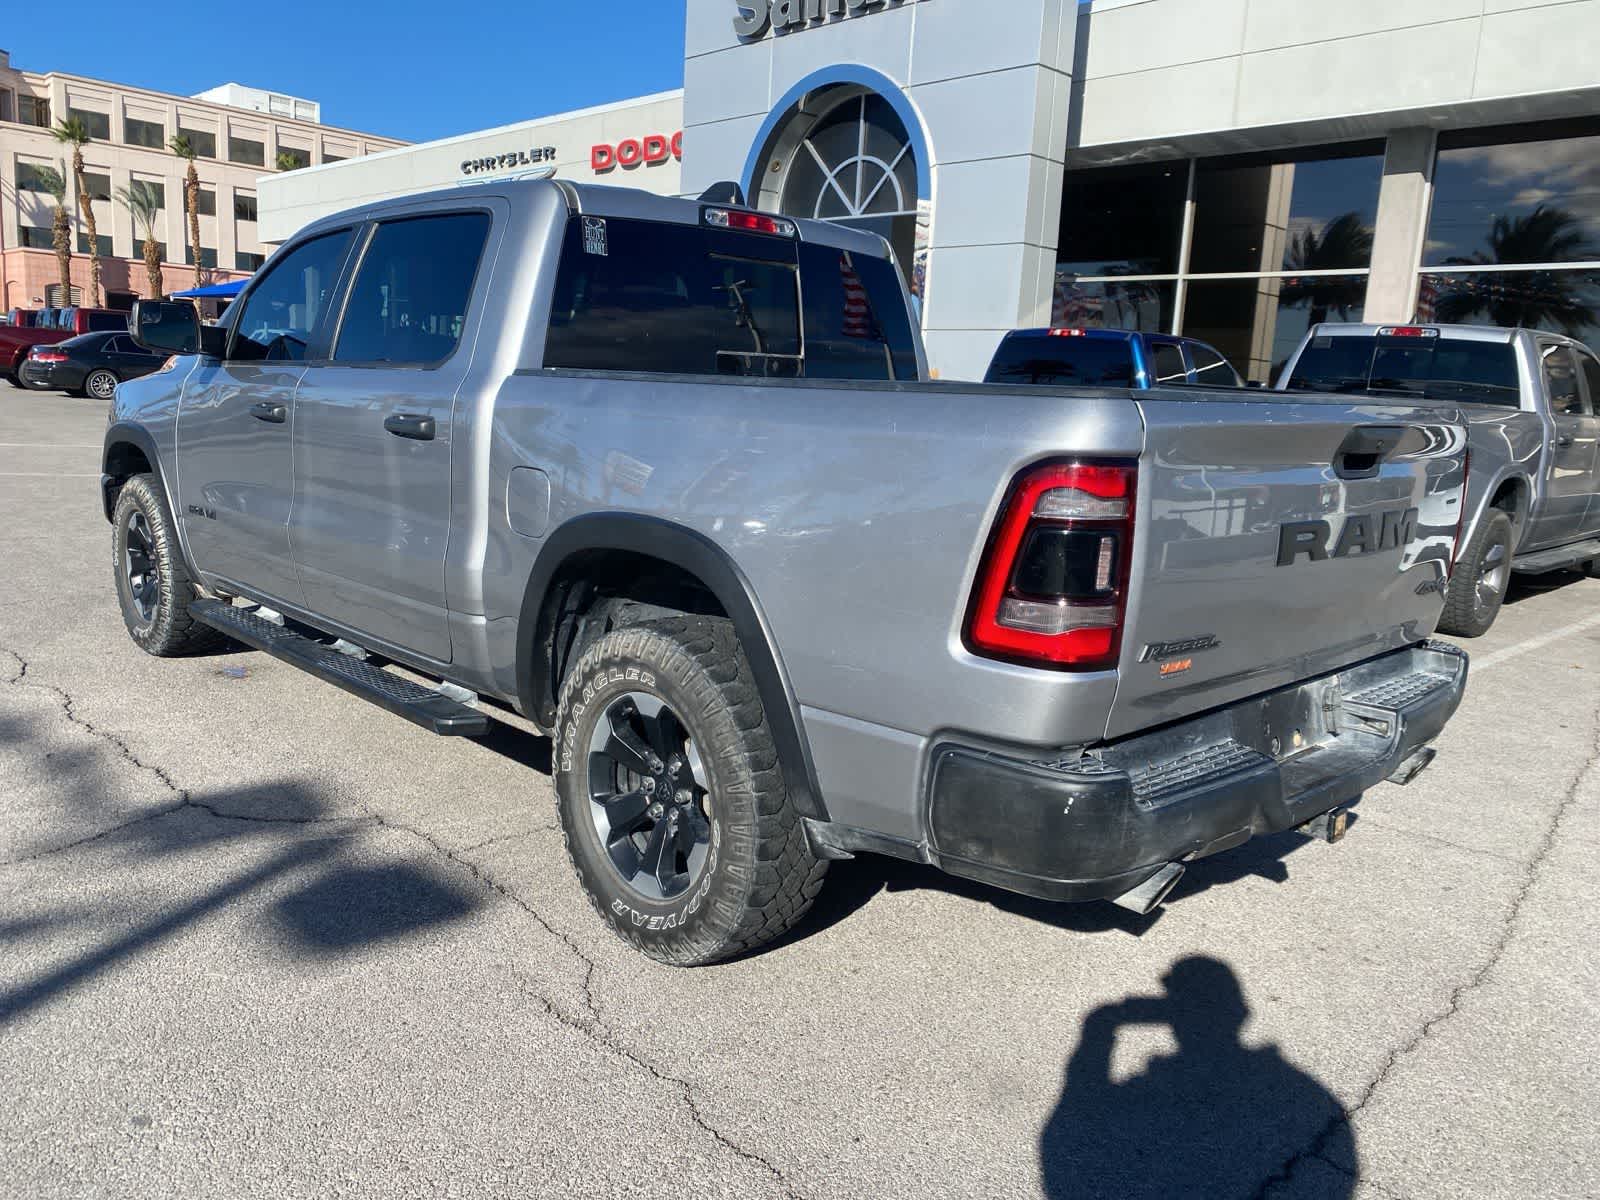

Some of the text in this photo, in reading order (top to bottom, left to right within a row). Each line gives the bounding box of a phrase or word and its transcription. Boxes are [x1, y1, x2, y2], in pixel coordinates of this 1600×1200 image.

[461, 145, 557, 174] CHRYSLER
[1275, 507, 1419, 567] RAM
[561, 667, 656, 772] WRANGLER
